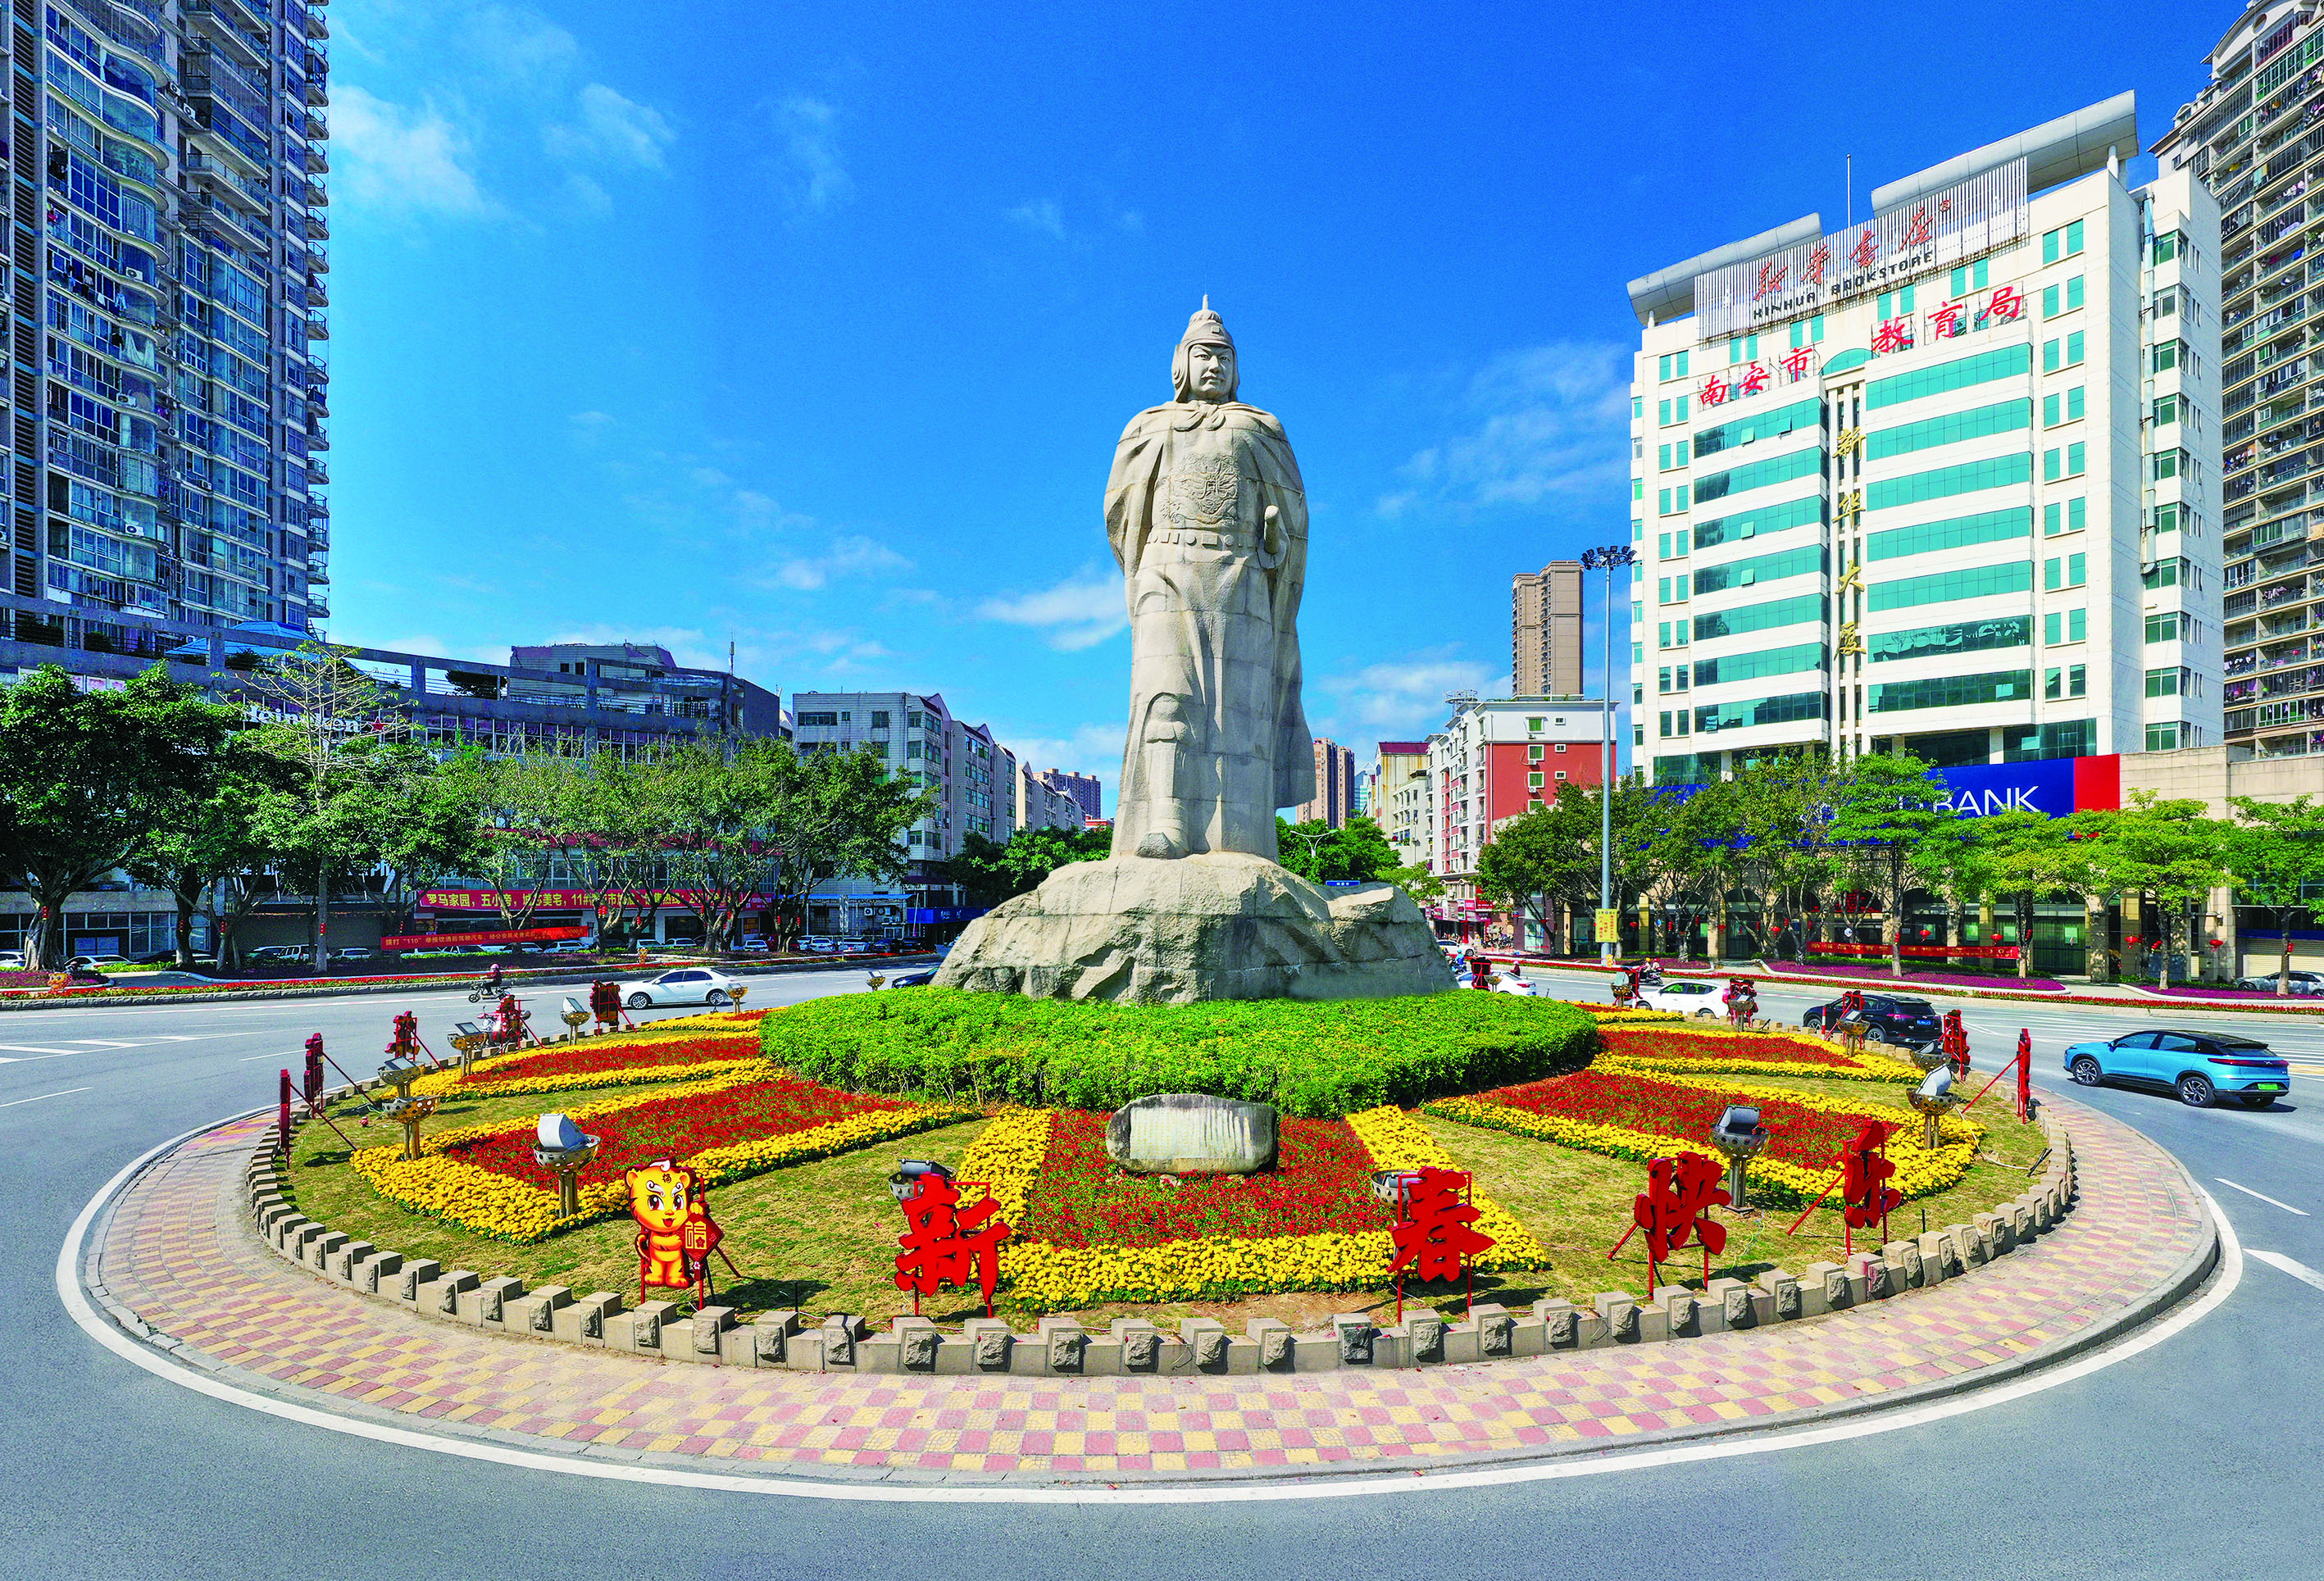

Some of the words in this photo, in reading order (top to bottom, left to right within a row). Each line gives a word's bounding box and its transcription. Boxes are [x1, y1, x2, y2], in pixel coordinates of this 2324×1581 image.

[1831, 251, 1934, 294] BOOKSTORE
[1699, 347, 1812, 406] 南安市
[1871, 286, 2024, 353] 教育局
[684, 1220, 707, 1250] 福
[895, 1171, 1012, 1305] 新
[1387, 1166, 1497, 1283] 春
[1634, 1151, 1732, 1264] 快
[1844, 1120, 1902, 1229] 乐
